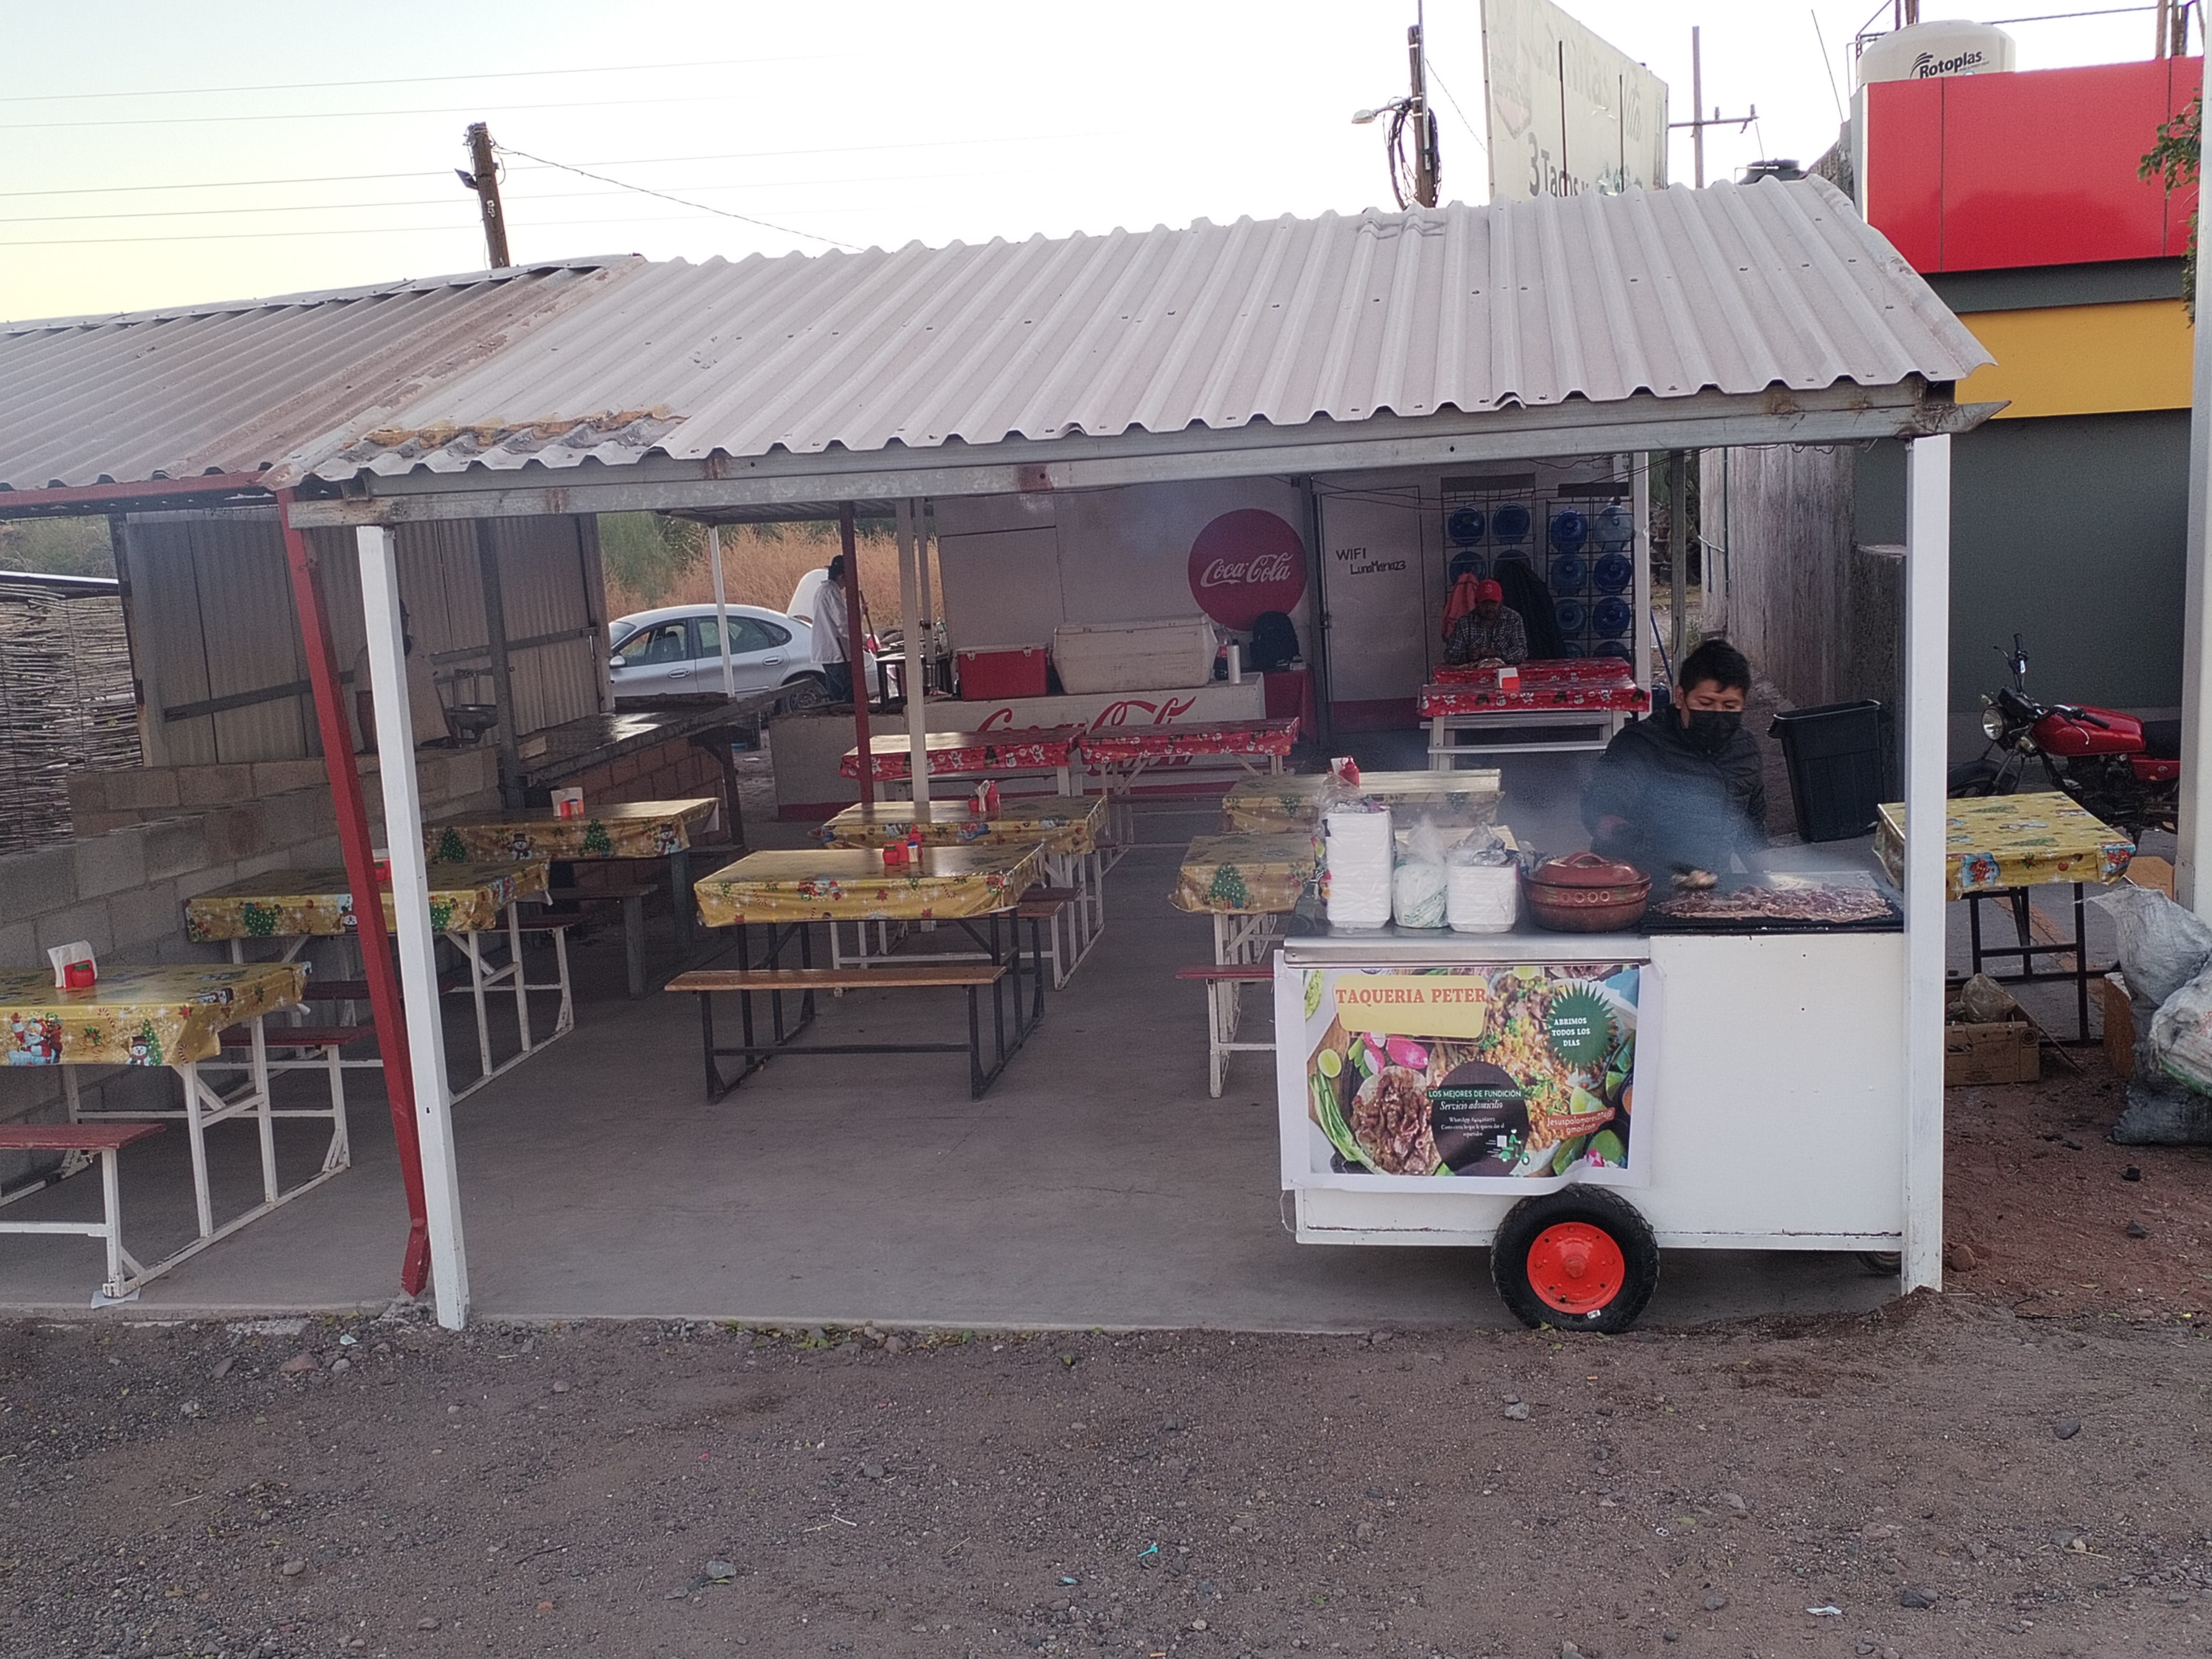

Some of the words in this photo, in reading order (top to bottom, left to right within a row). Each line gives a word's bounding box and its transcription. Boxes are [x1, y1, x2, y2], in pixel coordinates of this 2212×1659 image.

[1920, 51, 1982, 78] Rotoplas
[1528, 132, 1540, 197] 3
[1335, 548, 1366, 561] WIFI
[1201, 552, 1294, 588] Coca-Cola
[1336, 989, 1425, 1007] TAQUERIA
[1431, 988, 1486, 1003] PETER
[1443, 1090, 1472, 1098] MEJORES
[1484, 1088, 1522, 1097] FUNDICIÓN
[1440, 1101, 1467, 1110] Servicio
[1468, 1100, 1503, 1109] adomicilio
[1566, 1123, 1596, 1135] gmail.com
